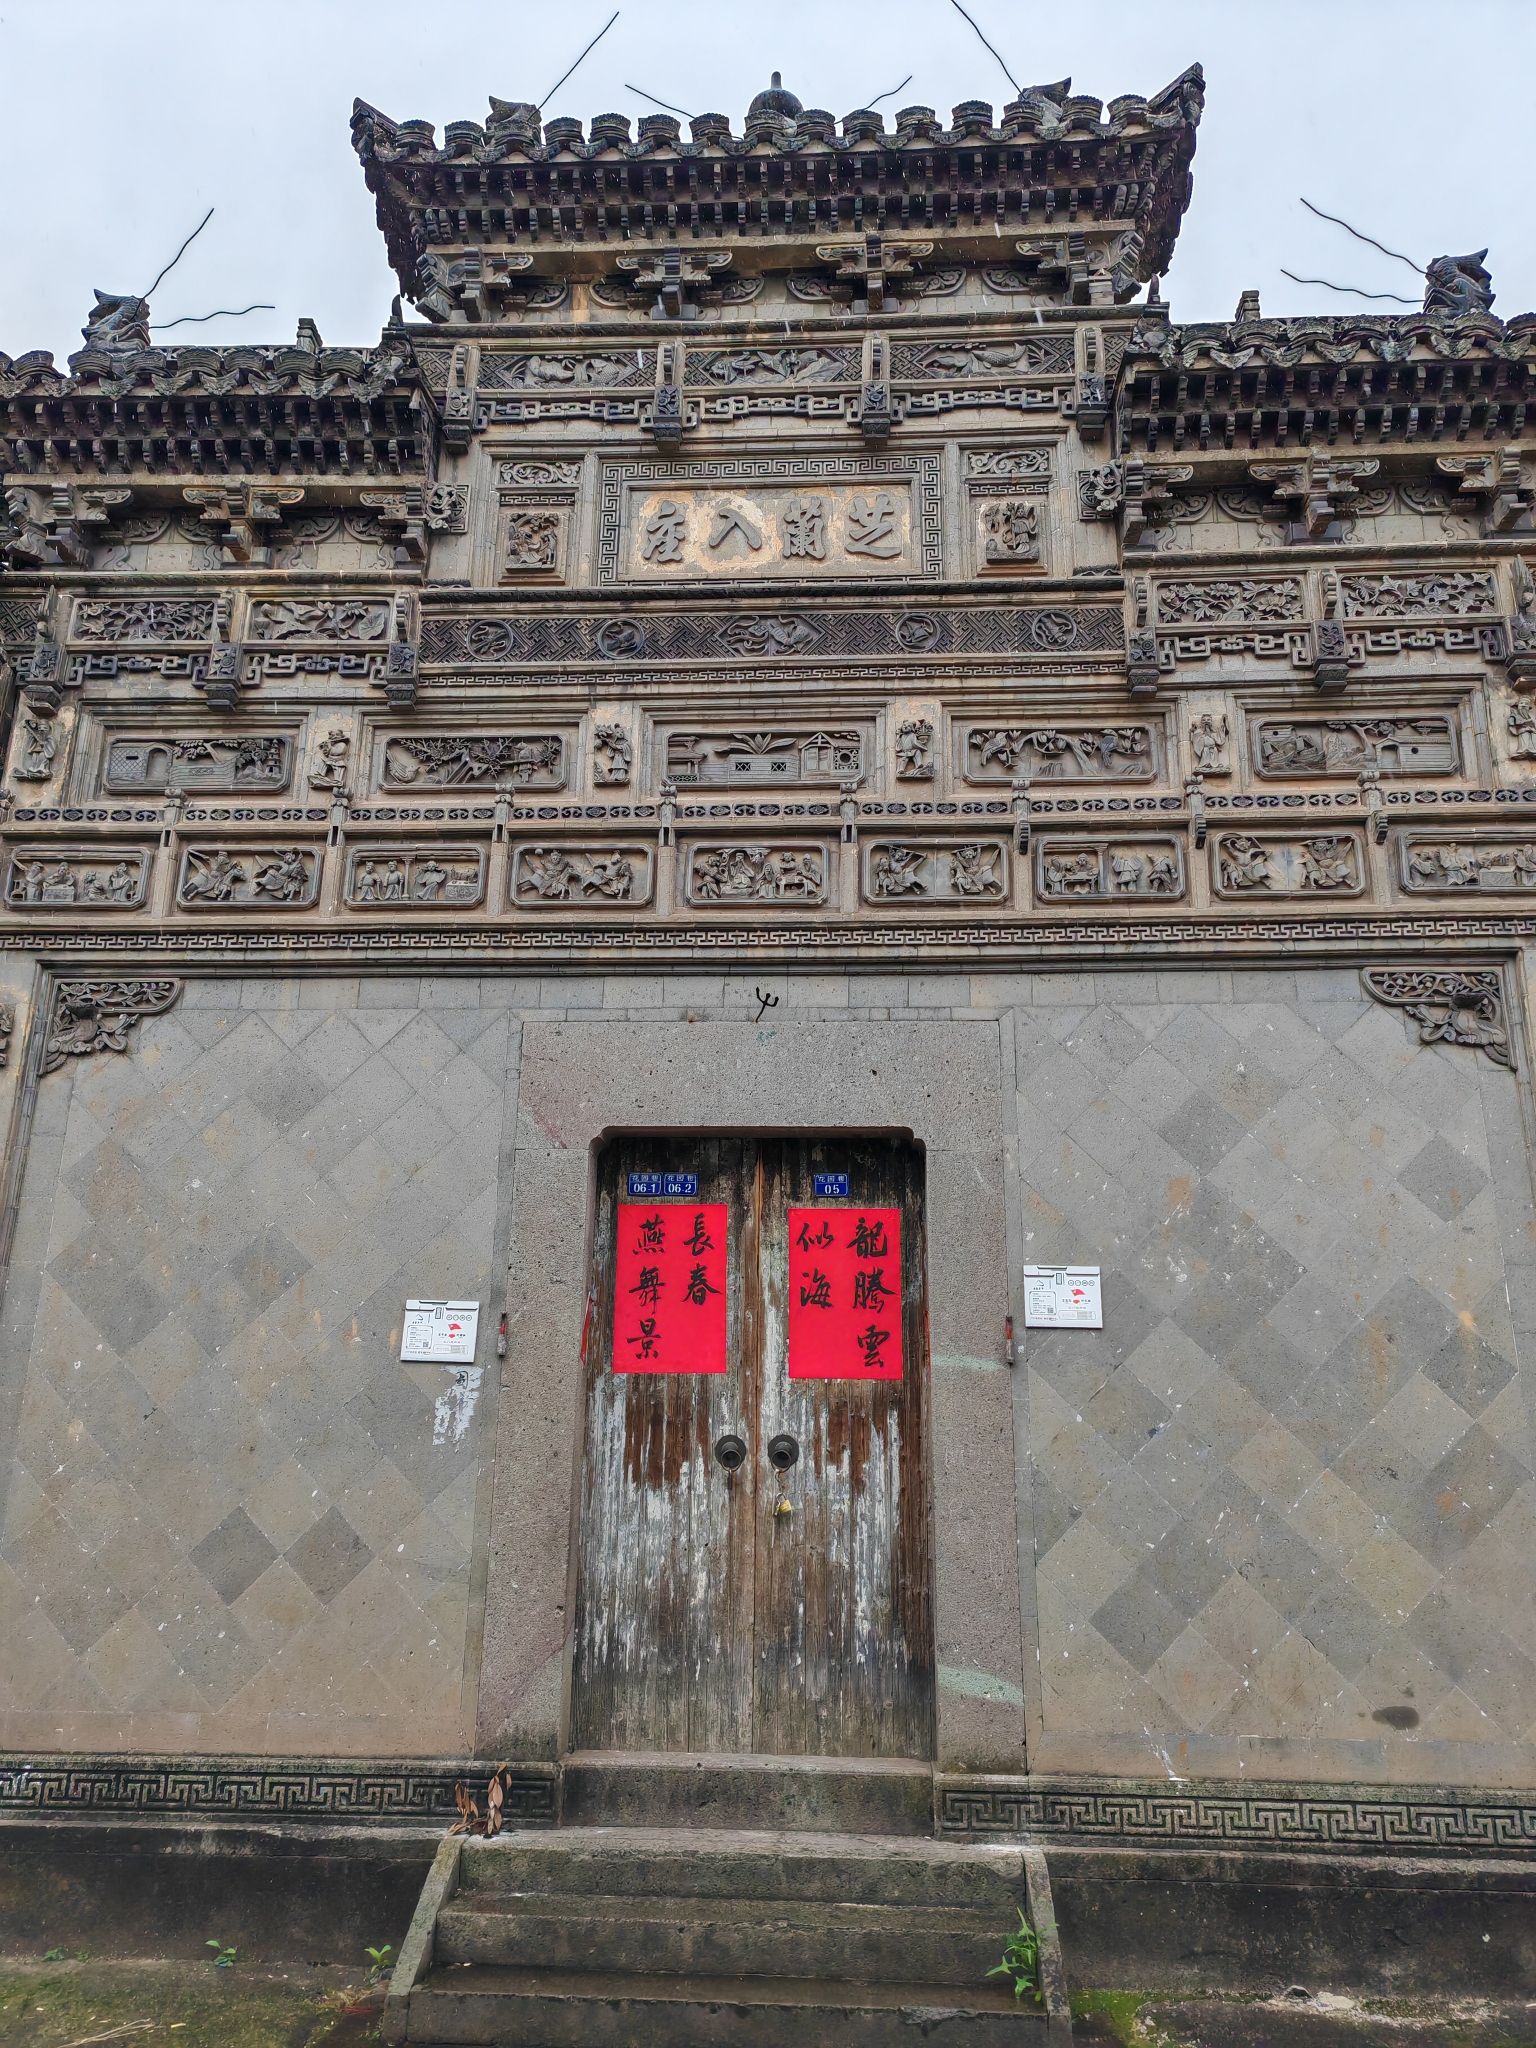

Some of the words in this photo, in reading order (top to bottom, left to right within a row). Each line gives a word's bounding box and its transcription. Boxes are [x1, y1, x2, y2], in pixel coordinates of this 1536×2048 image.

[633, 1183, 656, 1193] 06-1
[668, 1183, 692, 1193] 06-2
[824, 1184, 840, 1194] 05
[627, 1213, 666, 1360] 燕舞景
[682, 1213, 723, 1306] 長春
[796, 1221, 834, 1310] 似海
[847, 1217, 896, 1368] 龍騰雲
